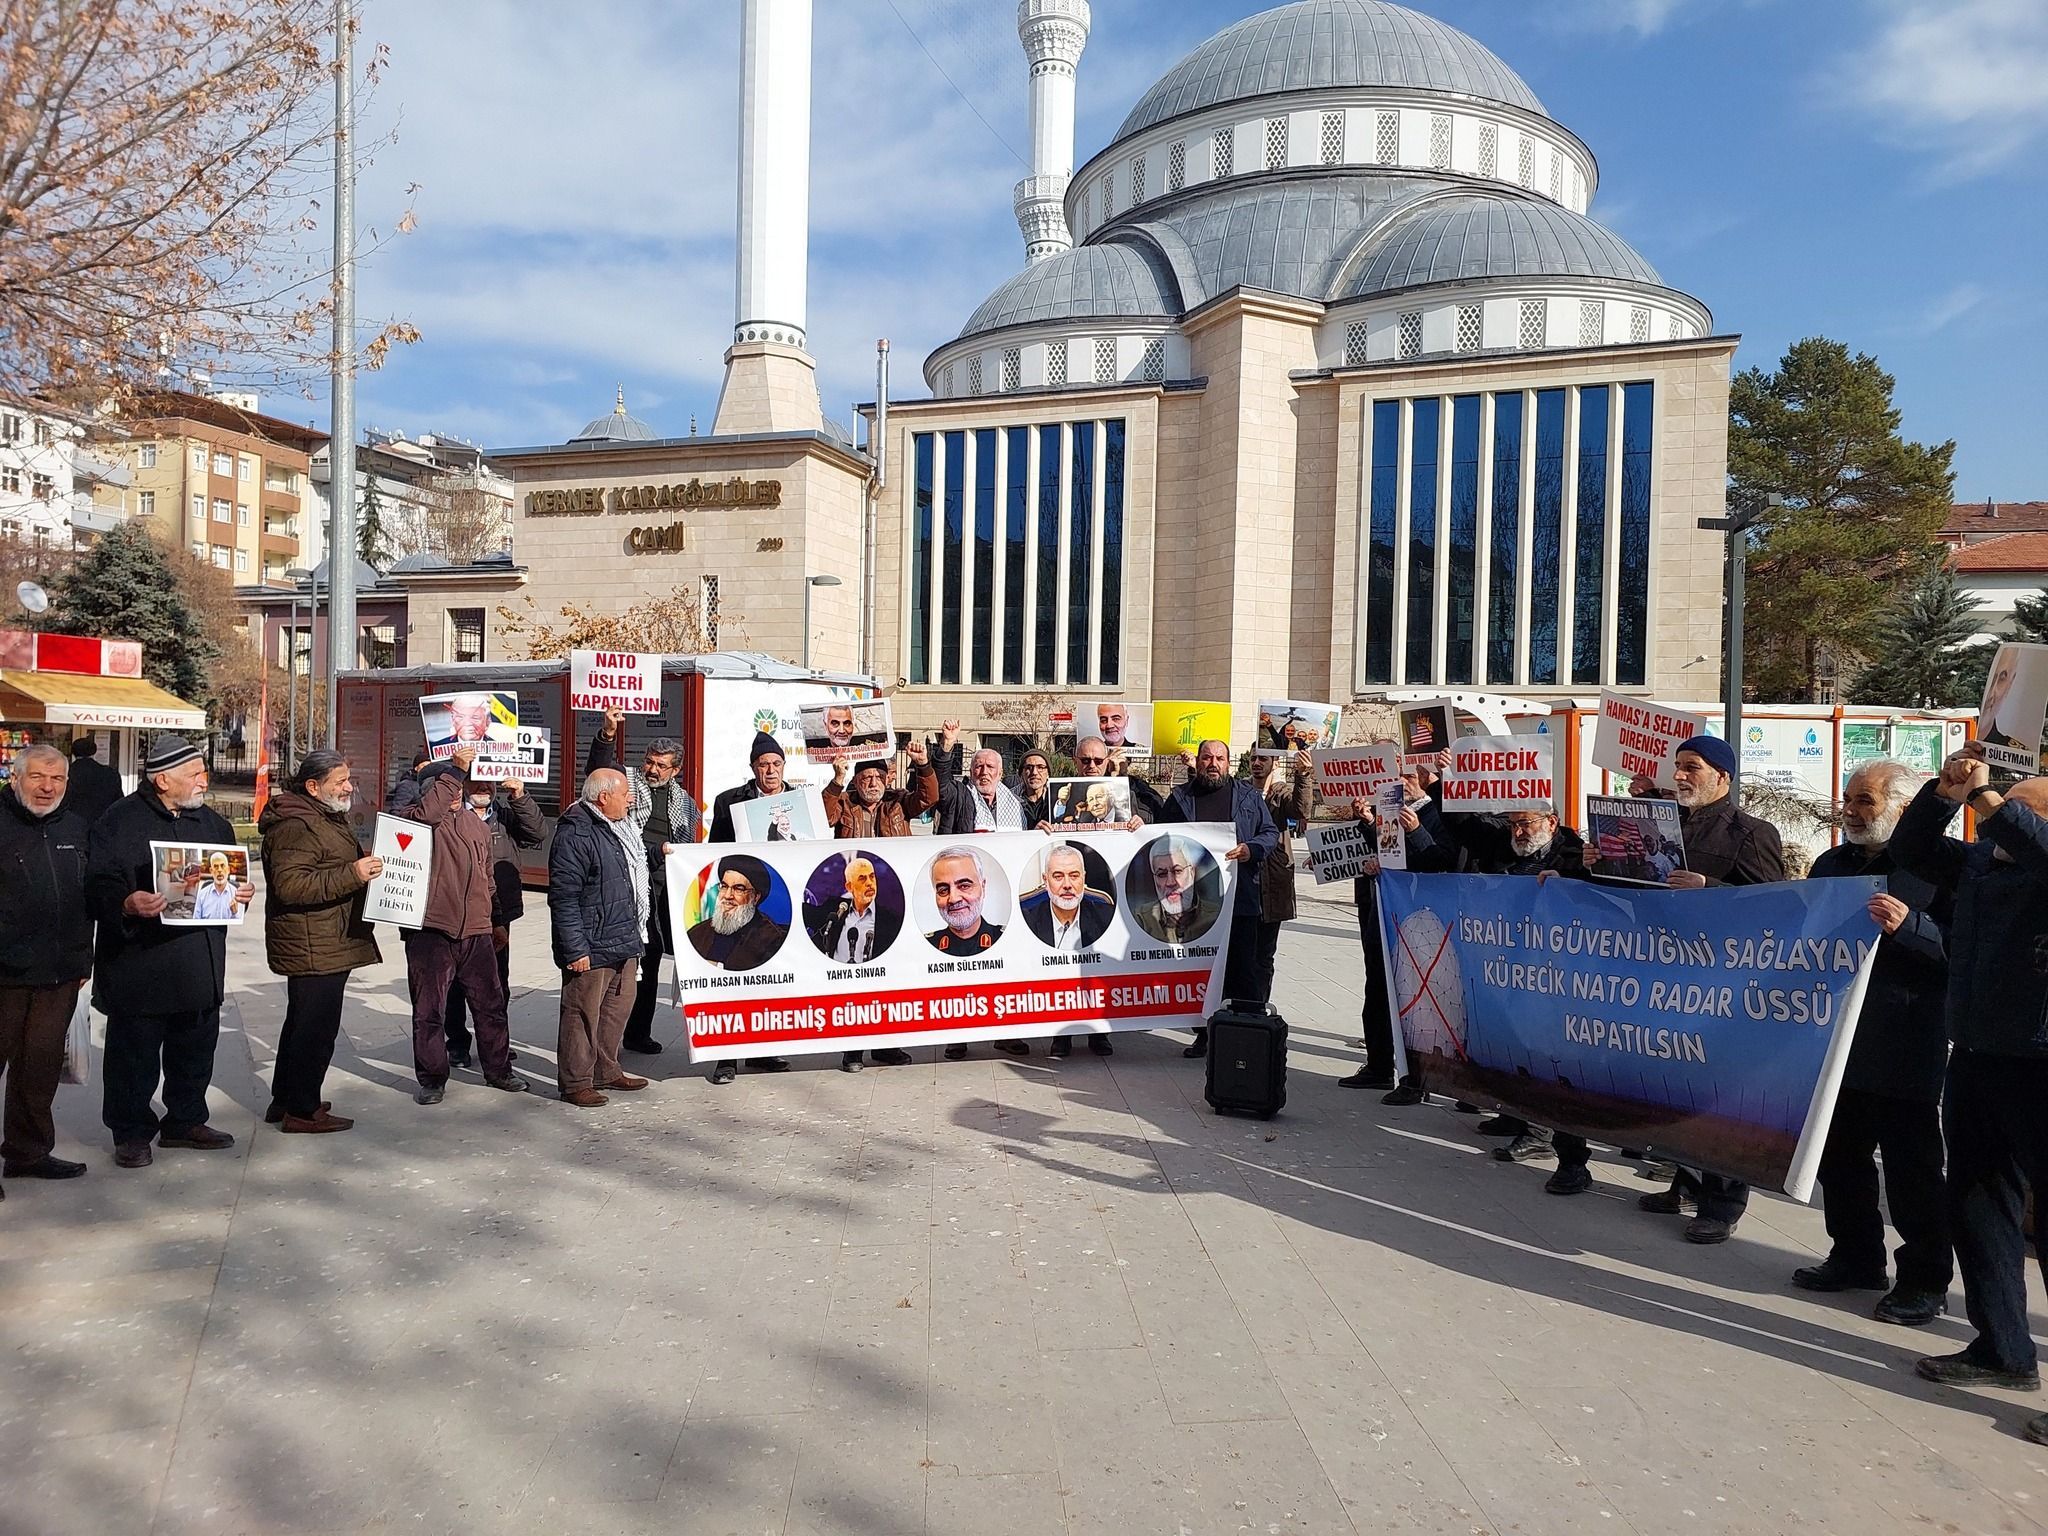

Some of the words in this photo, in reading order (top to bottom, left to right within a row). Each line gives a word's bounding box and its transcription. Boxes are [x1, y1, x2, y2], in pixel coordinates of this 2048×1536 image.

[528, 488, 605, 513] KERNEK
[613, 477, 782, 510] KARAGÖZLÜLER
[596, 653, 636, 669] NATO
[588, 671, 643, 691] ÜSLERİ
[572, 694, 660, 712] KAPATILSIN
[73, 712, 133, 724] YALÇIN
[143, 715, 184, 726] BÜFE
[1606, 699, 1650, 730] HAMAS'A
[1653, 714, 1695, 739] SELAM
[488, 742, 515, 755] TRUMP
[1619, 726, 1669, 758] DİRENİŞE
[1800, 747, 1823, 756] MASKİ
[1323, 755, 1387, 777] KÜRECİK
[1456, 747, 1539, 773] KÜRECİK
[1621, 751, 1659, 779] DEVAM
[1988, 747, 2034, 768] SÜLEYMANİ
[477, 765, 545, 778] KAPATILSIN
[1320, 777, 1398, 798] KAPATILS
[1443, 778, 1552, 800] KAPATILSIN
[1589, 799, 1648, 819] KAHROLSUN
[1652, 805, 1674, 821] ABD
[1311, 846, 1344, 866] NATO
[385, 871, 416, 884] DENİZE
[384, 883, 413, 898] ÖZGÜR
[1131, 950, 1146, 960] EBU
[1149, 947, 1175, 960] MEHDİ
[1177, 948, 1186, 958] EL
[1188, 945, 1219, 958] MÜHEN
[1549, 918, 1716, 968] GÜVENLİĞİNİ
[928, 961, 955, 974] KASIM
[957, 959, 1004, 973] SÜLEYMANİ
[1042, 953, 1070, 966] İSMAİL
[1072, 952, 1101, 965] HANİYE
[711, 976, 740, 987] HASAN
[743, 972, 795, 986] NASRALLAH
[827, 968, 853, 981] YAHYA
[855, 966, 886, 979] SİNVAR
[1483, 955, 1566, 997] KÜRECİK
[1572, 971, 1641, 1007] NATO
[1648, 980, 1733, 1018] RADAR
[1743, 979, 1833, 1027] ÜSSÜ
[752, 1004, 826, 1032] DİRENİŞ
[929, 994, 988, 1019] KUDÜS
[994, 987, 1106, 1019] ŞEHİDLERİNE
[1111, 985, 1170, 1007] SELAM
[1565, 1013, 1707, 1064] KAPATILSIN
